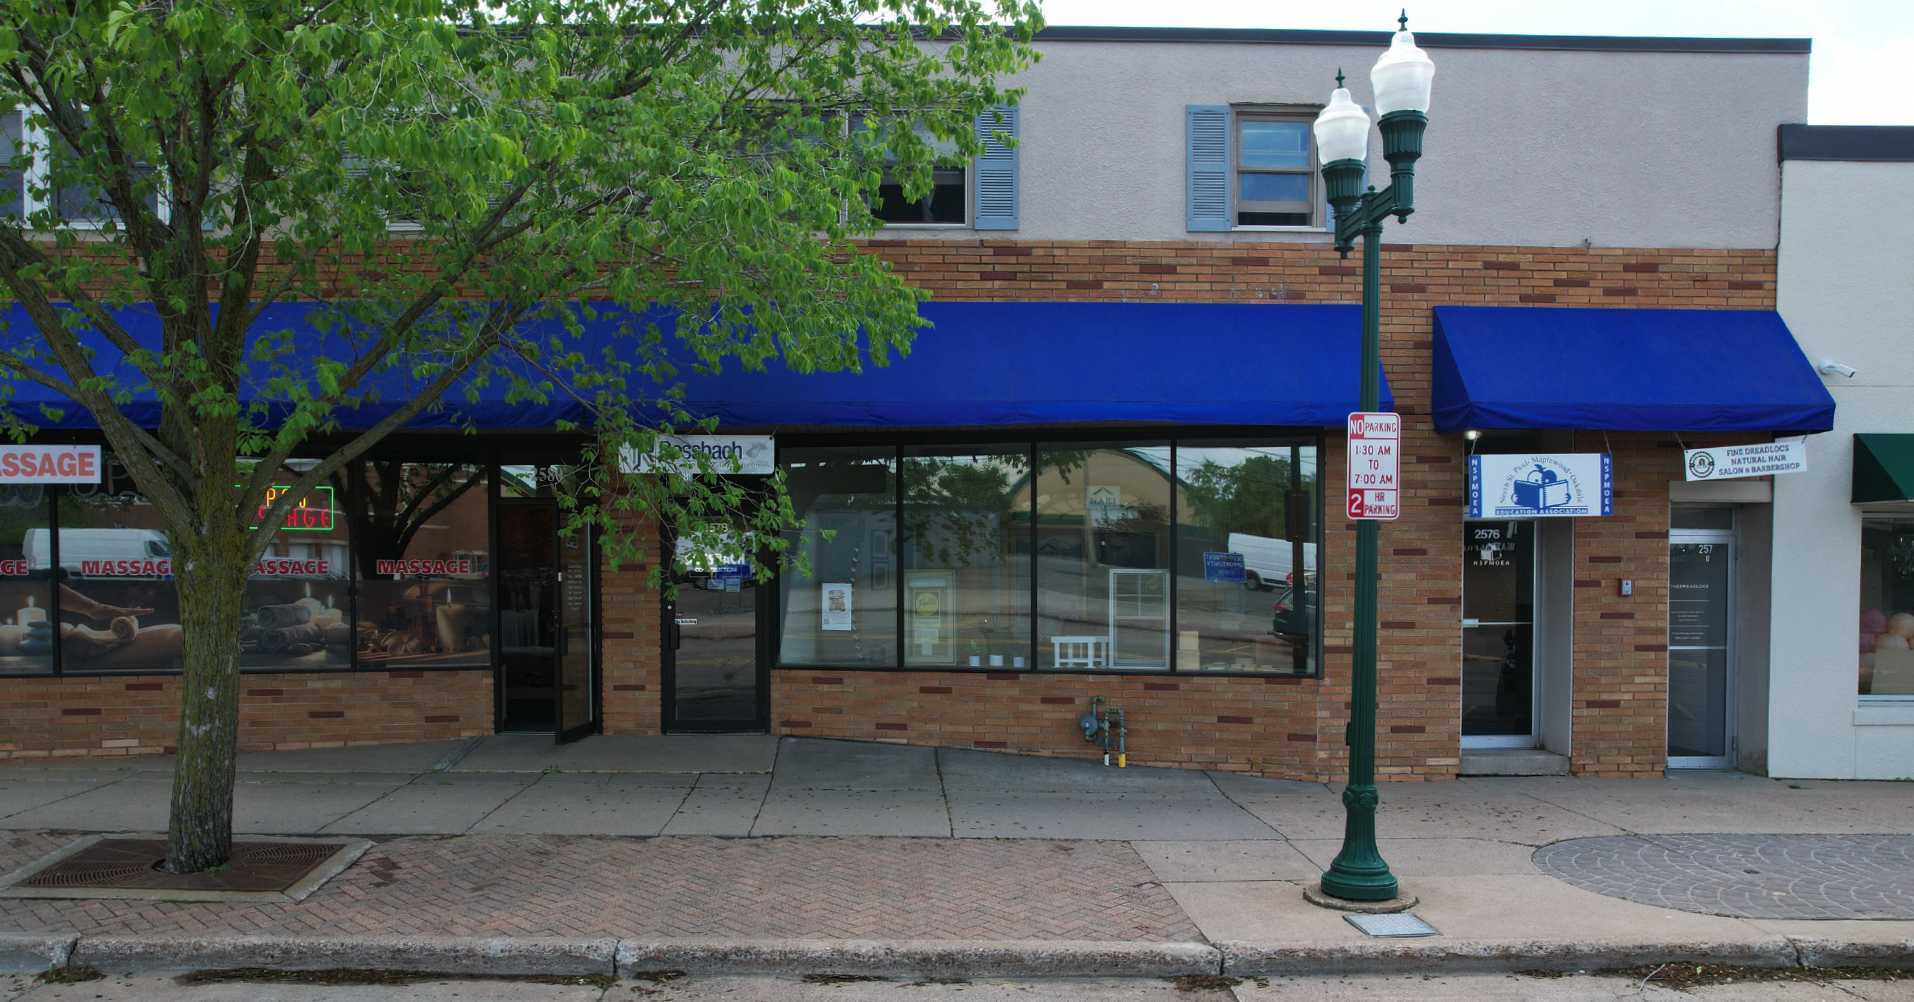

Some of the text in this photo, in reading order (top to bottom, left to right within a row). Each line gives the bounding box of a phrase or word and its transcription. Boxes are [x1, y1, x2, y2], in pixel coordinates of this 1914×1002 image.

[1350, 419, 1397, 435] NO PARKING
[1355, 445, 1391, 456] 1:30 AM
[1726, 444, 1790, 457] FINE DREADLOCS
[0, 452, 95, 477] SSAGE
[1368, 459, 1379, 470] TO
[1731, 454, 1787, 466] NATURAL HAIR
[531, 467, 564, 482] 2580
[1718, 467, 1744, 476] SALON
[1751, 462, 1800, 473] BARBERSHOP
[1355, 474, 1393, 485] 7:00 AM
[1500, 482, 1510, 504] North
[1531, 456, 1571, 474] Maplewood
[1570, 474, 1584, 504] Oakdale
[1350, 492, 1385, 513] 2 HR
[1364, 504, 1396, 515] PARKING
[1495, 508, 1538, 516] EDUCATION
[1474, 529, 1501, 540] 2576
[1698, 544, 1713, 554] 257
[81, 560, 174, 575] MASSAG
[253, 560, 328, 575] ASSAGE
[377, 560, 470, 575] MASSAGE
